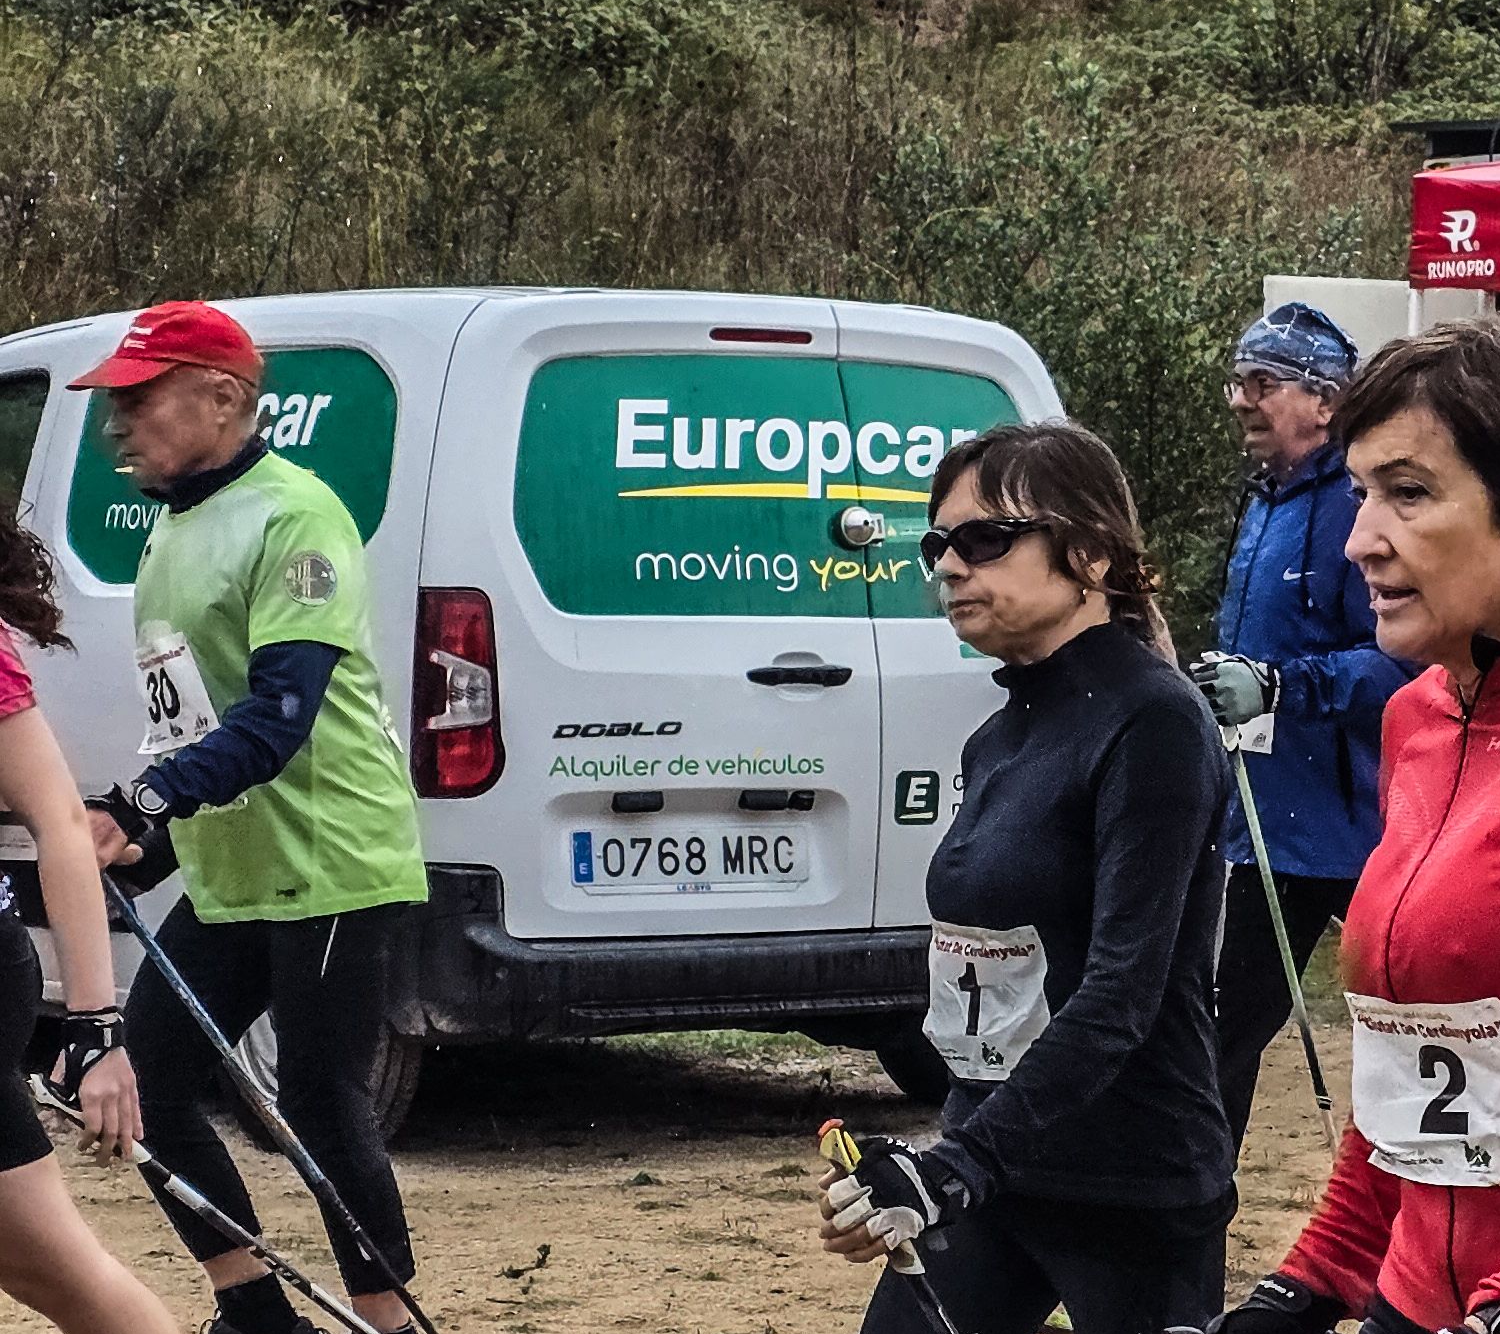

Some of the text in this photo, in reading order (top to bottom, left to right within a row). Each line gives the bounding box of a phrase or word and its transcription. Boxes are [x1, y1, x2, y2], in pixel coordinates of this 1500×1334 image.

[634, 545, 799, 591] moving
[809, 556, 912, 591] your
[146, 667, 181, 725] 30
[552, 721, 683, 740] DOBLO
[549, 746, 825, 782] Alquiler de vehículos
[602, 836, 707, 878] 0768
[721, 835, 794, 875] MRC
[957, 961, 982, 1037] 1
[1418, 1044, 1470, 1135] 2
